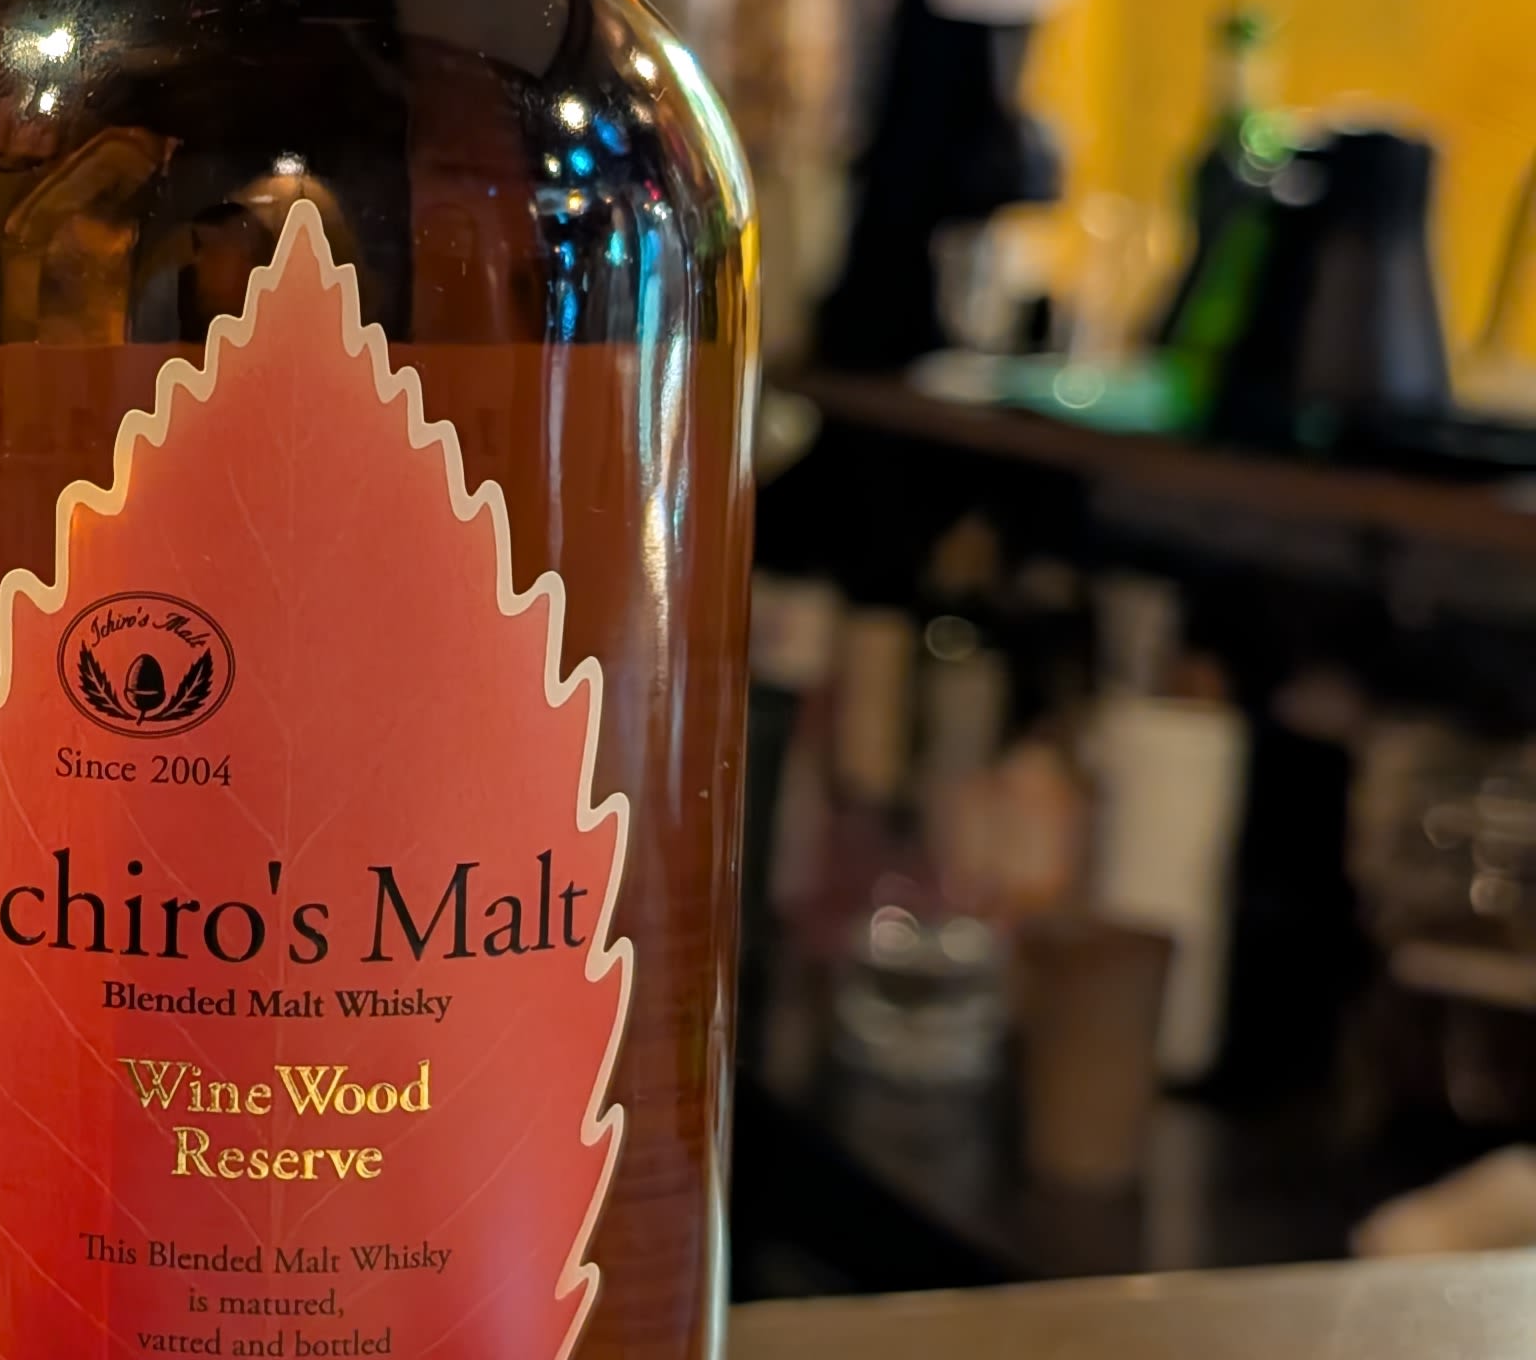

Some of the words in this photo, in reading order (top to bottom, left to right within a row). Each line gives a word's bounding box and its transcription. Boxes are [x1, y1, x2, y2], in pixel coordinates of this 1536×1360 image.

[91, 606, 150, 648] Ichiro's
[152, 612, 210, 649] Malt
[55, 746, 136, 782] Since
[150, 754, 232, 787] 2004
[360, 848, 588, 962] Malt
[102, 980, 236, 1019] Blended
[247, 990, 325, 1020] Malt
[337, 990, 453, 1023] Whisky
[117, 1058, 273, 1116] Wine
[274, 1059, 432, 1115] Wood
[171, 1126, 384, 1180] Reserve
[81, 1232, 138, 1268] This
[148, 1239, 263, 1274] Blended
[273, 1244, 341, 1276] Malt
[350, 1240, 453, 1274] Whisky
[187, 1287, 209, 1315] is
[218, 1288, 345, 1319] matured,
[136, 1328, 224, 1357] vatted
[231, 1329, 285, 1359] and
[294, 1328, 392, 1357] bottled
